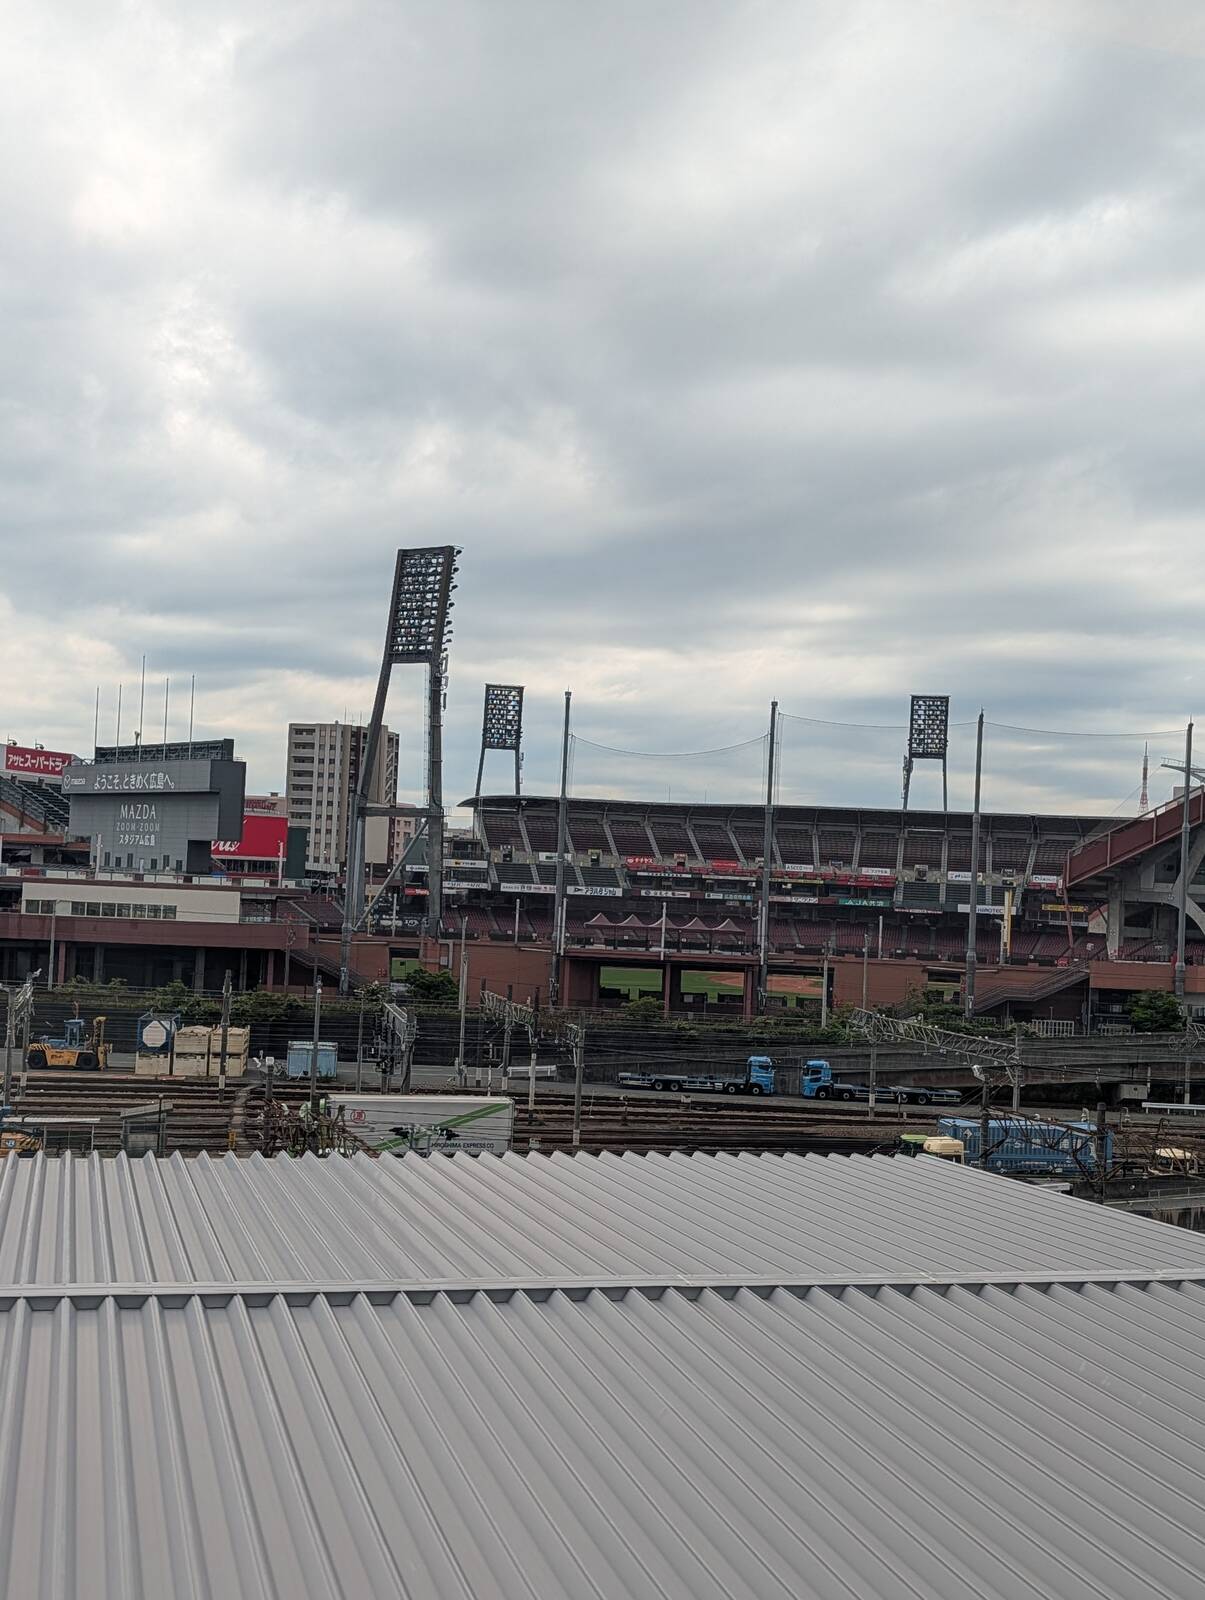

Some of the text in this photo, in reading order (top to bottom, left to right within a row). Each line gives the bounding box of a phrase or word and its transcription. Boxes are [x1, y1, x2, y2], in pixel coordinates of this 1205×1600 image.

[120, 804, 157, 819] MAZDA
[119, 834, 156, 846] スタジアム広島
